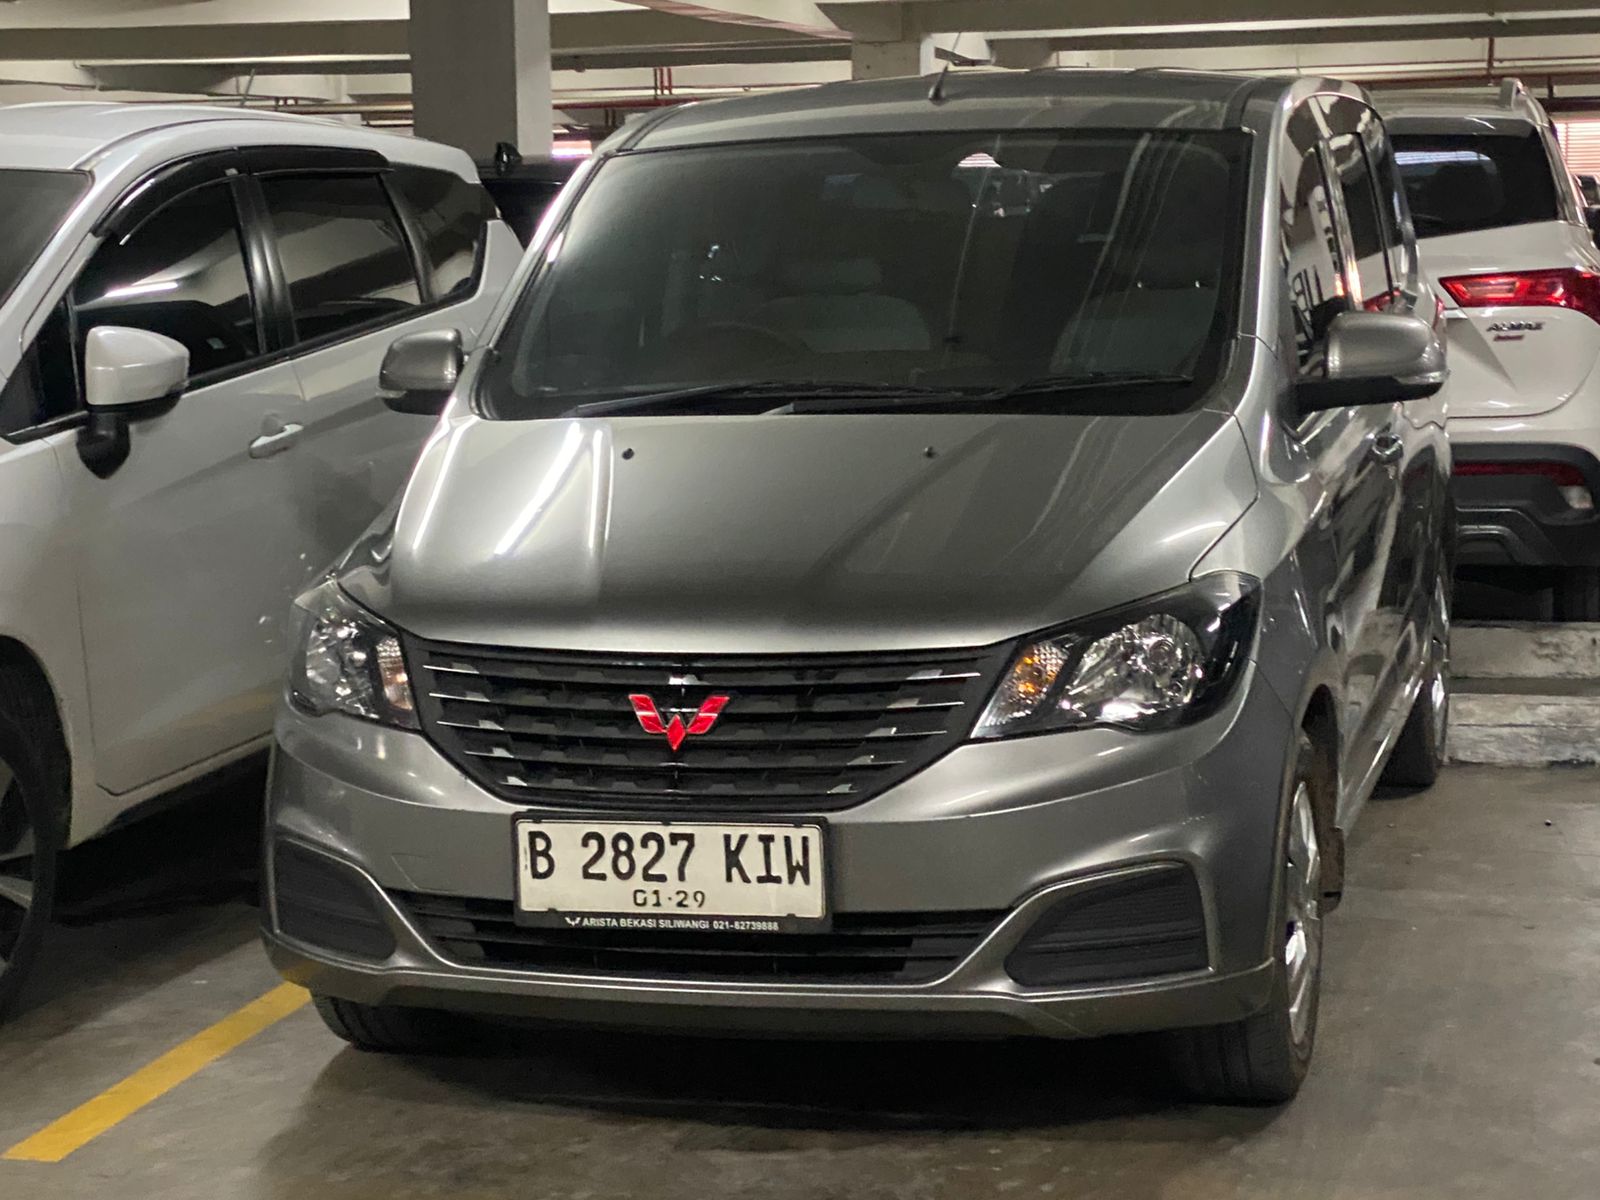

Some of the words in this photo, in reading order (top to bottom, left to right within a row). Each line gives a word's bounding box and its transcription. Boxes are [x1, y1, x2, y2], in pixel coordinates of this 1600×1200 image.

[528, 831, 555, 880] B
[581, 832, 696, 883] 2827
[723, 833, 811, 886] KIW
[582, 917, 619, 927] ARISTA
[620, 918, 657, 928] BEKASI
[658, 919, 710, 929] SILIWANGI
